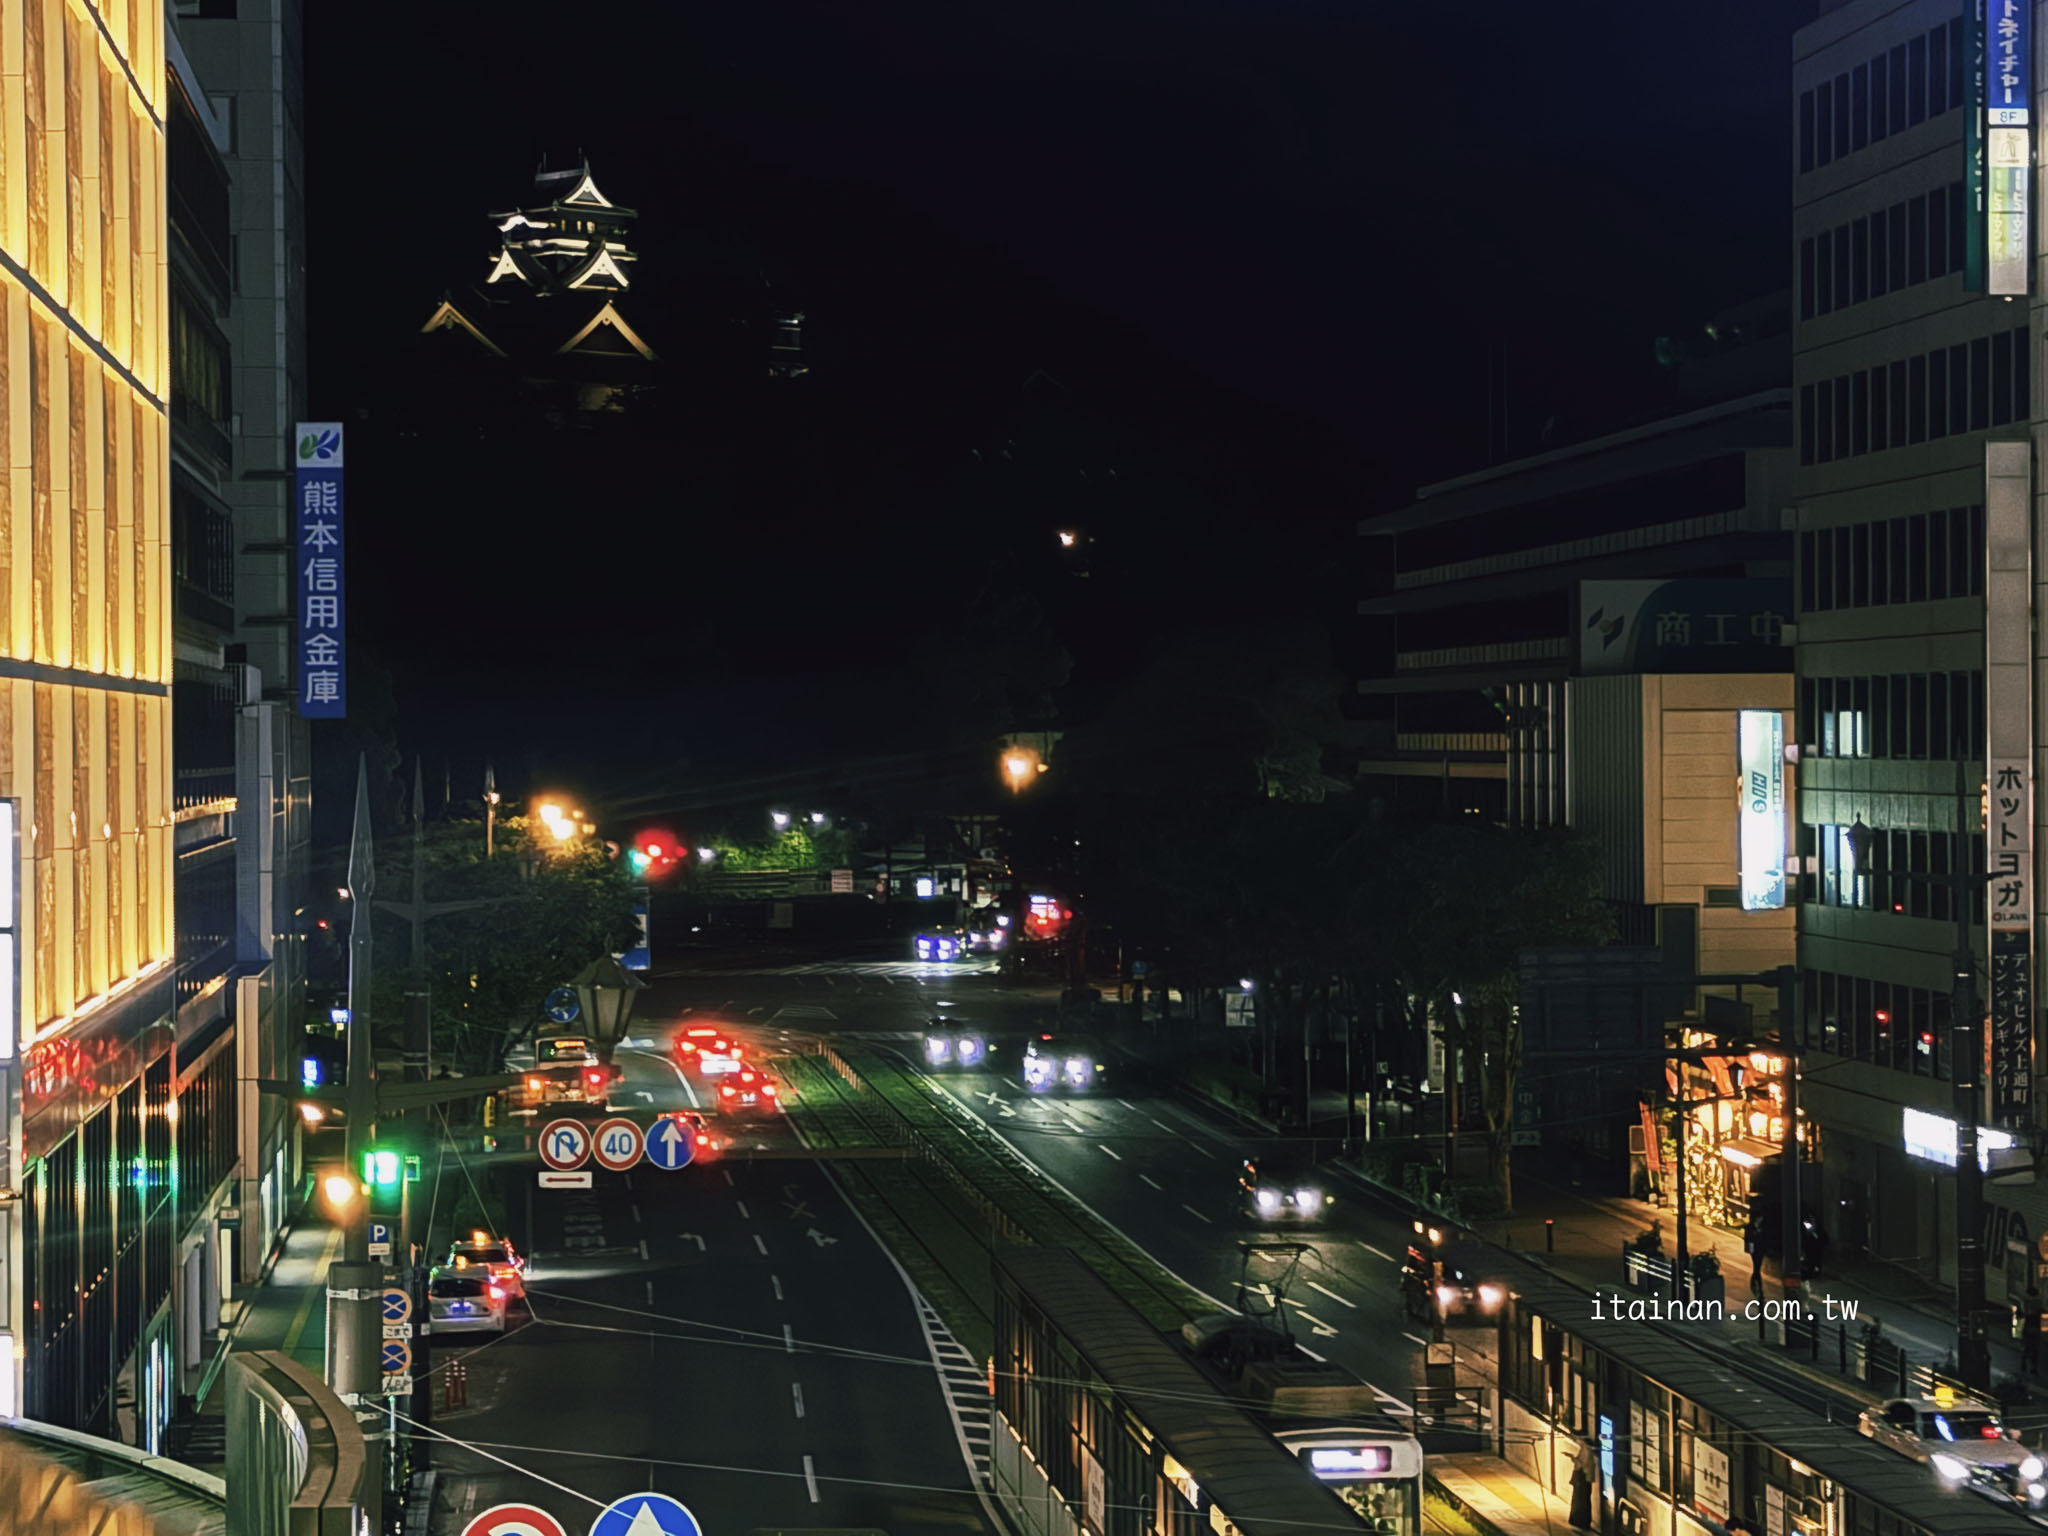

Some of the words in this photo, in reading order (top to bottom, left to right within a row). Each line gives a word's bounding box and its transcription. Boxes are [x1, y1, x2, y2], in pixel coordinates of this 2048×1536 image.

[2000, 112, 2017, 123] 8F
[303, 480, 340, 705] 熊本信用金庫
[1996, 766, 2024, 907] ホットヨガ
[605, 1133, 632, 1156] 40
[373, 1225, 386, 1242] P
